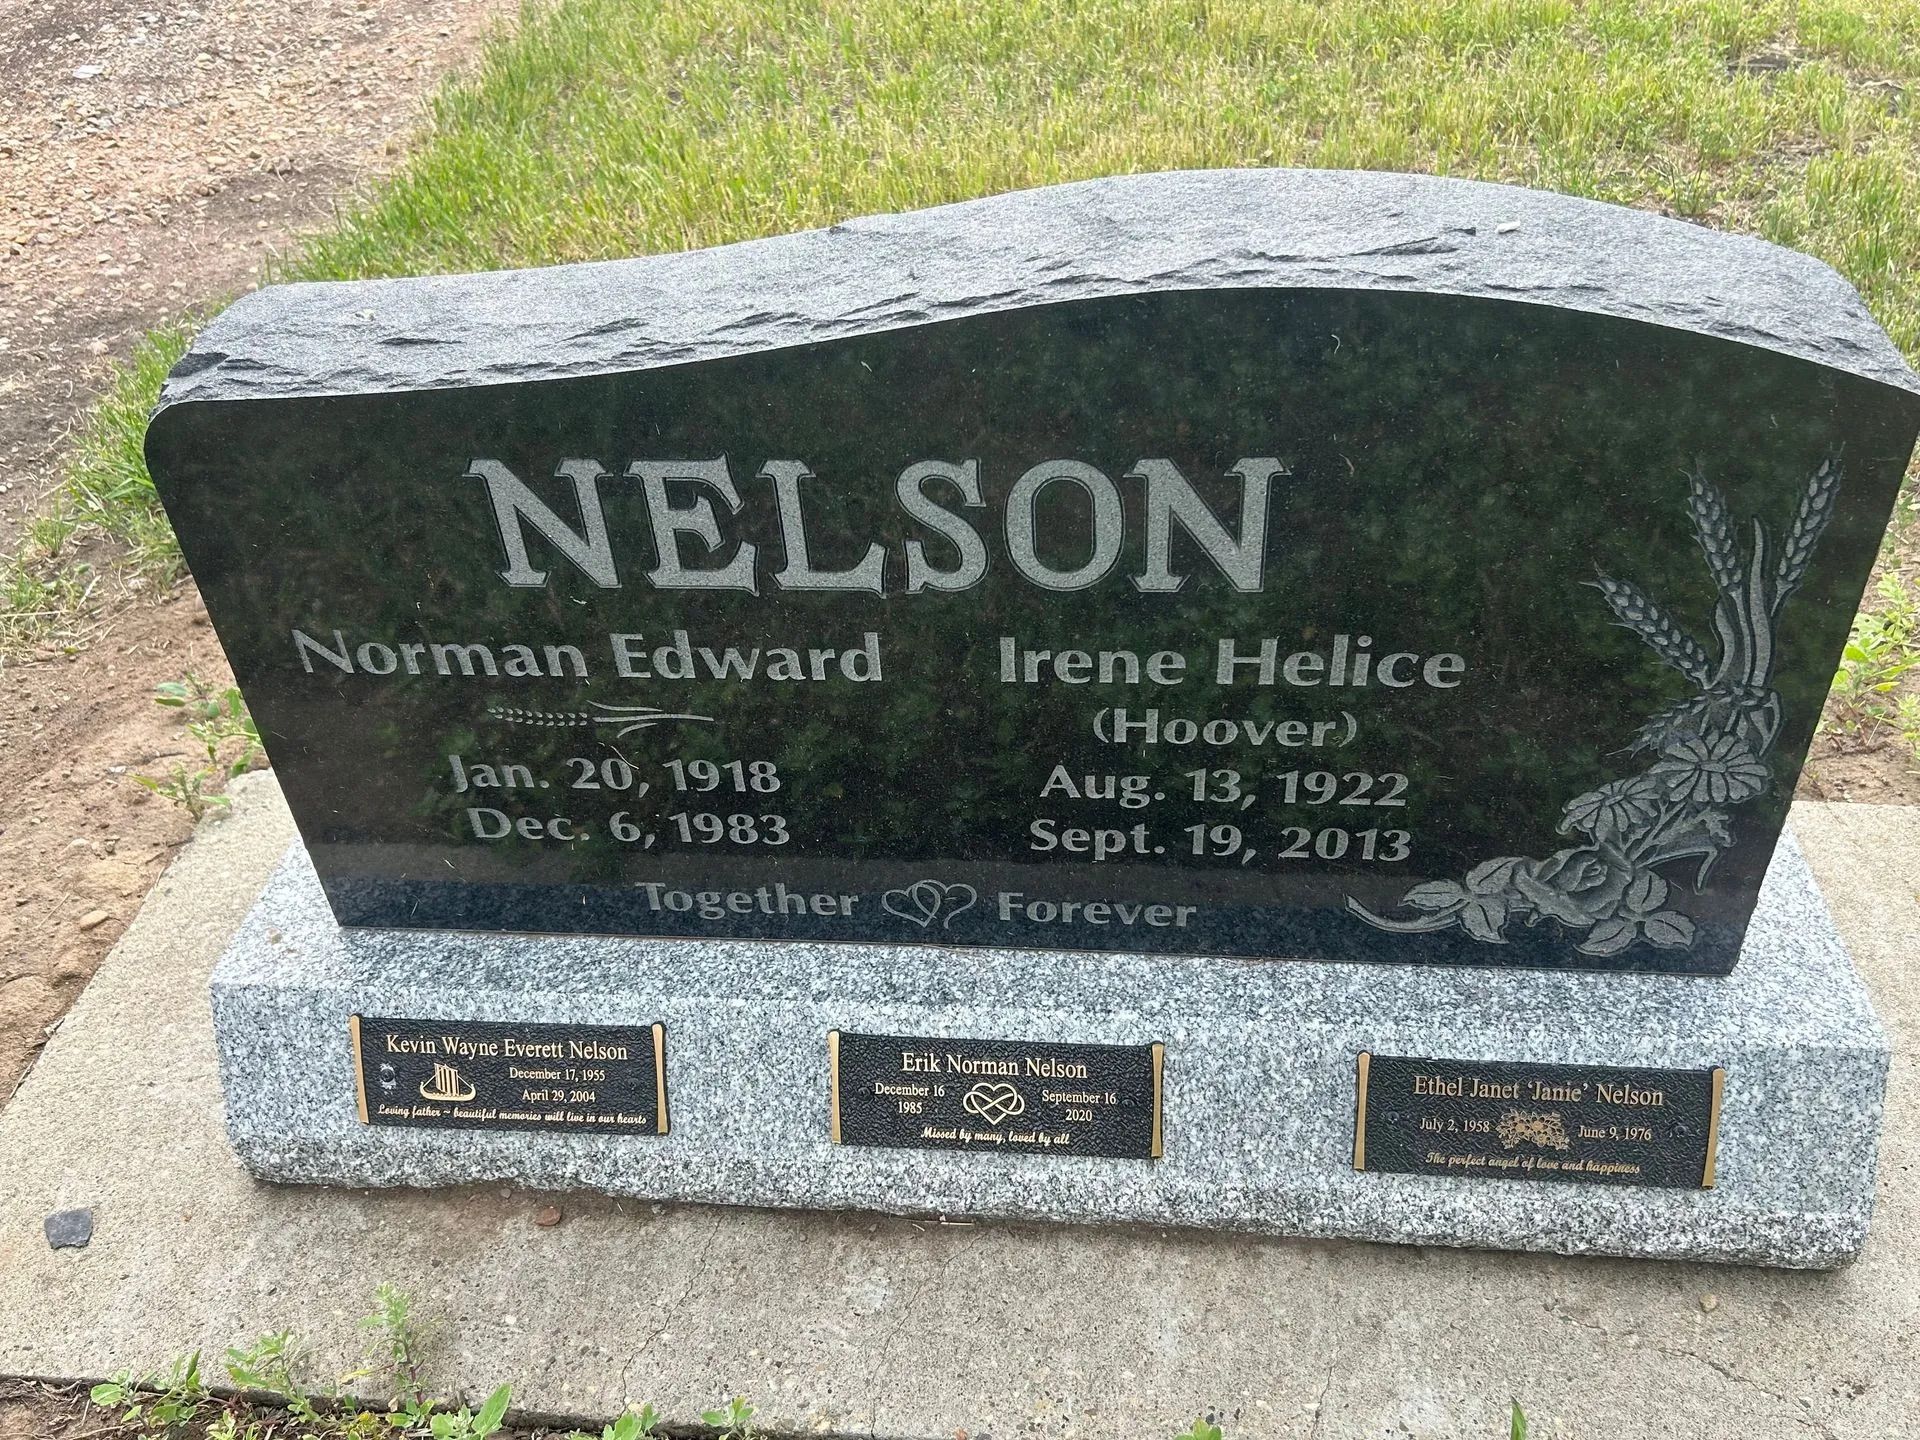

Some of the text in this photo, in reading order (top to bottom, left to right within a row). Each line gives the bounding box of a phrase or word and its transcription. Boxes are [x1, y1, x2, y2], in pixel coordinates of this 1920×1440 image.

[462, 453, 1290, 598] NELSON
[292, 628, 884, 682] Norman Edward
[999, 634, 1466, 689] Irene Helice
[1093, 708, 1358, 749] (Hoover)
[448, 754, 782, 798] Jan. 20, 1918
[1039, 765, 1410, 809] Aug. 13, 1922
[466, 808, 791, 849] Dec. 6, 1983
[1029, 818, 1412, 865] Sept. 19, 2013
[635, 881, 1197, 926] Together Forever
[386, 1035, 628, 1060] Kevin Wayne Everett Nelson
[510, 1067, 606, 1083] December 17, 1955
[901, 1052, 1088, 1078] Erik Norman Nelson
[522, 1089, 596, 1104] April 29, 2004
[874, 1083, 945, 1097] December 16
[1042, 1090, 1116, 1106] September 16
[1414, 1075, 1463, 1097] Ethel
[1469, 1078, 1519, 1100] Janet
[1596, 1083, 1664, 1106] Nelson
[378, 1104, 409, 1119] Loving
[412, 1106, 441, 1119] father
[453, 1107, 496, 1121] beautiful
[499, 1110, 542, 1121] memories
[545, 1110, 564, 1122] will
[567, 1110, 584, 1123] live
[587, 1113, 596, 1123] in
[598, 1114, 615, 1124] our
[617, 1113, 647, 1125] hearts
[898, 1102, 923, 1114] 1985
[1065, 1109, 1093, 1122] 2020
[921, 1126, 1070, 1145] Missed by many, loved by all
[1419, 1118, 1490, 1134] July 2, 1958
[1578, 1125, 1652, 1141] June 9, 1976
[1425, 1151, 1641, 1175] The perfect angel of love and happiness
